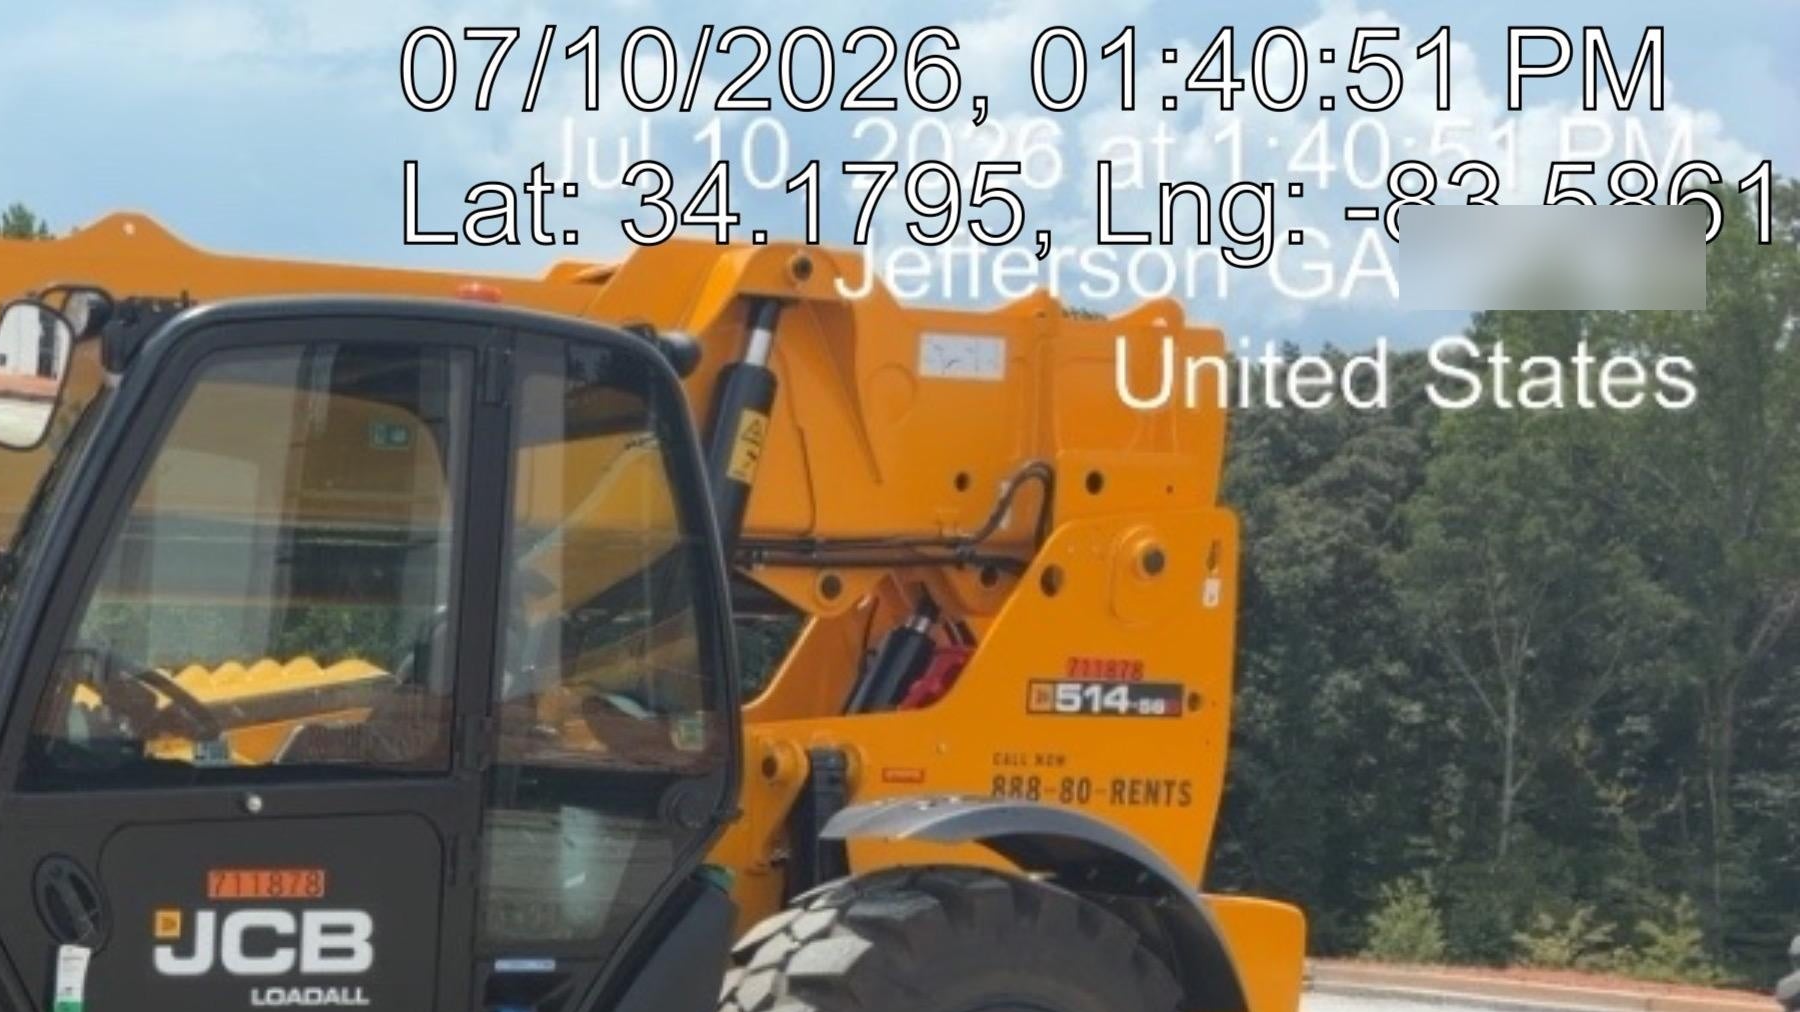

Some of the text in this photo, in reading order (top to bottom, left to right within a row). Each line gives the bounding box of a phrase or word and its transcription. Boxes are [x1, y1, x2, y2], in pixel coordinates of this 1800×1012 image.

[991, 774, 1193, 808] 888-80-RENTS
[213, 871, 322, 898] 711878
[154, 910, 374, 976] JCB
[251, 987, 370, 1006] LOADALL
